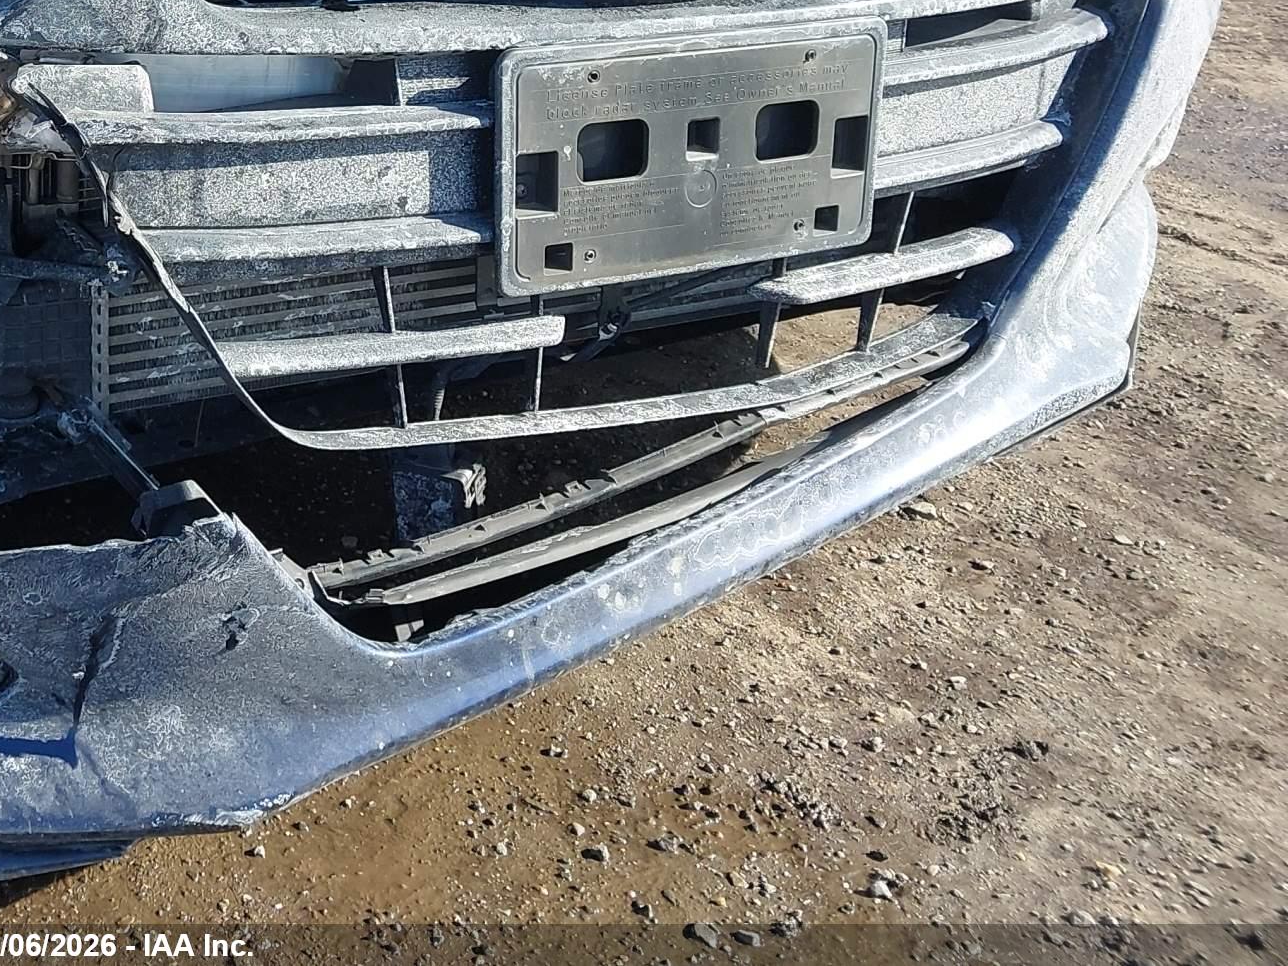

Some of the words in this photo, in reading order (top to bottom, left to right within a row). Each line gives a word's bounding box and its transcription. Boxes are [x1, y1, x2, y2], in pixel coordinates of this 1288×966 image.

[546, 88, 609, 103] License
[614, 82, 655, 96] Plate
[660, 78, 702, 93] frame
[708, 75, 723, 87] or
[729, 65, 817, 85] accessories
[822, 63, 850, 76] may
[546, 104, 587, 120] block
[593, 100, 634, 117] radar
[704, 90, 730, 104] See
[735, 84, 794, 100] Owner's
